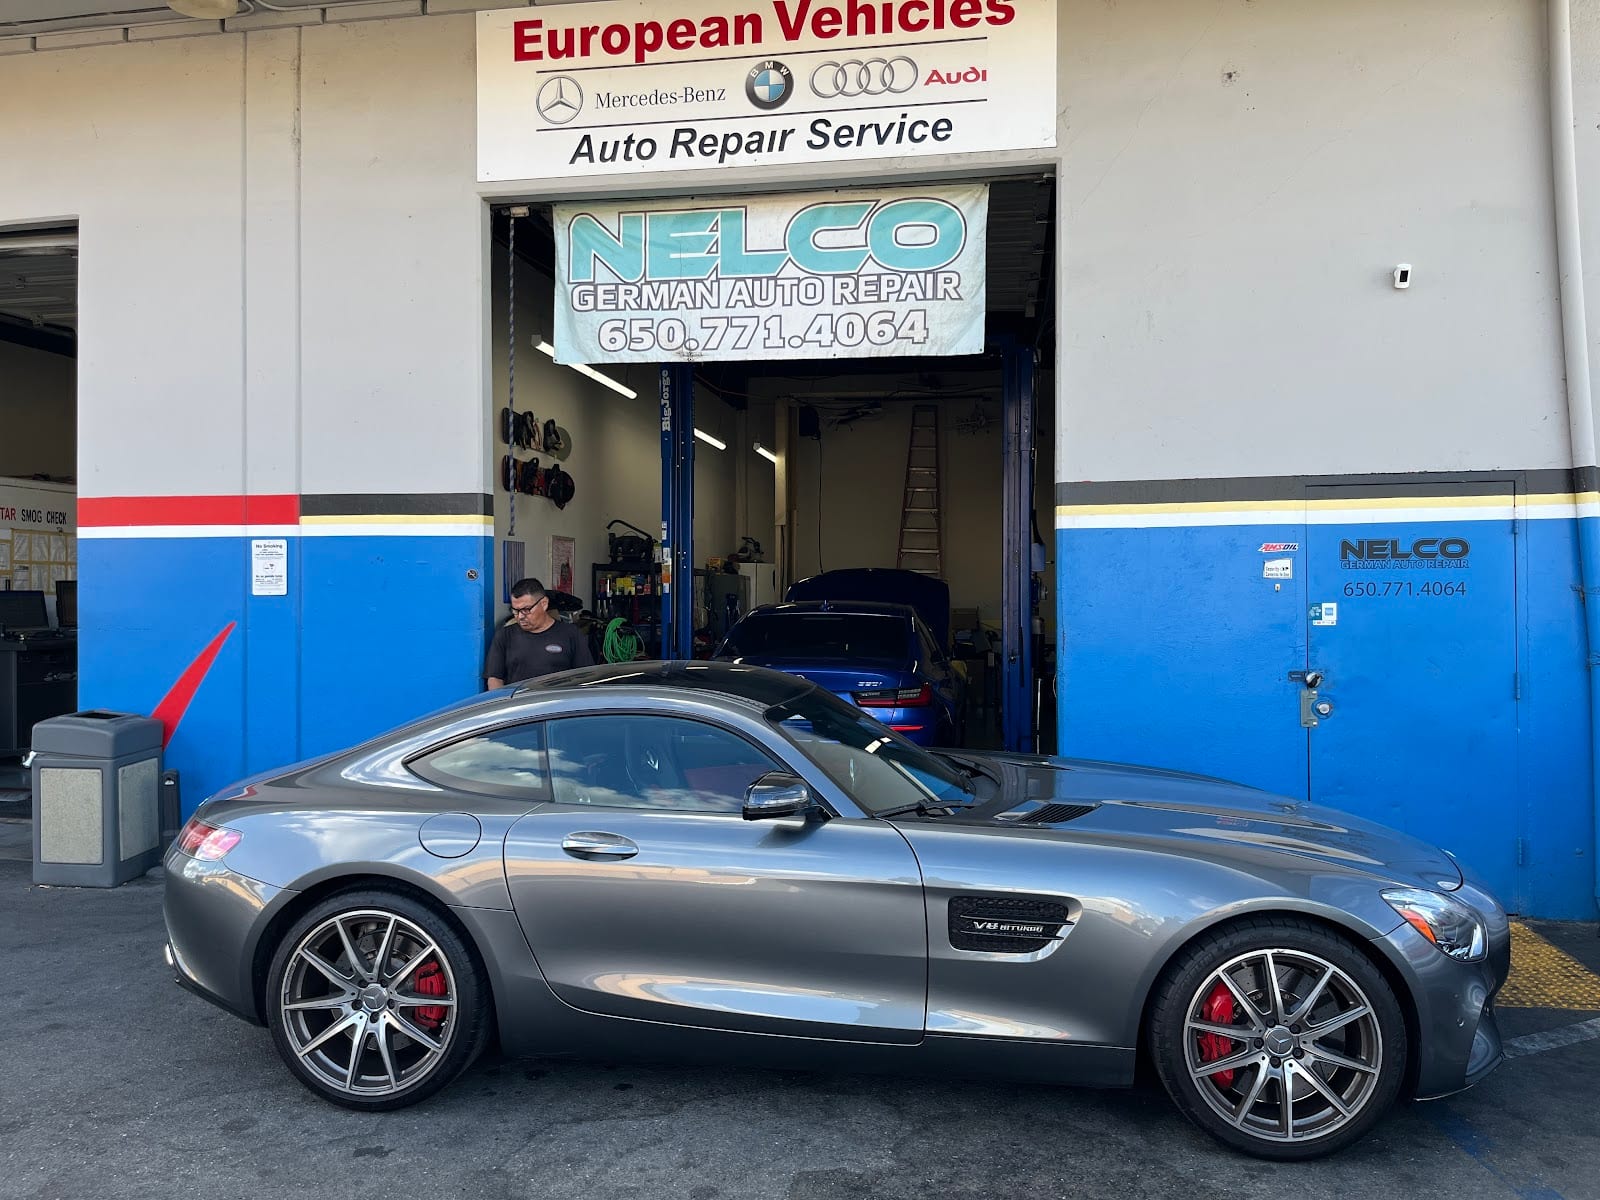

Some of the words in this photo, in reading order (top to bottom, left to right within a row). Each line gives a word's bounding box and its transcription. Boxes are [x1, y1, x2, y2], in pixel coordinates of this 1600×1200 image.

[513, 12, 763, 64] European
[773, 0, 1016, 41] Vehicles
[923, 66, 988, 86] Audi
[594, 86, 727, 110] Mercedes-Benz
[569, 132, 658, 165] Auto
[669, 127, 796, 164] Repair
[806, 113, 953, 151] Service
[567, 197, 968, 284] NELCO
[571, 280, 720, 313] GERMAN
[726, 275, 825, 309] AUTO
[833, 270, 963, 307] REPAIR
[598, 309, 930, 353] 650.771.4064
[21, 508, 43, 524] SMOG
[46, 510, 67, 525] CHECK
[1339, 537, 1470, 560] NELCO
[1340, 559, 1391, 570] GERMAN
[1392, 559, 1427, 569] AUTO
[1427, 558, 1470, 569] REPAIR
[1343, 581, 1467, 597] 650.771.4064
[973, 921, 999, 930] V8
[999, 923, 1044, 933] BITURBO
